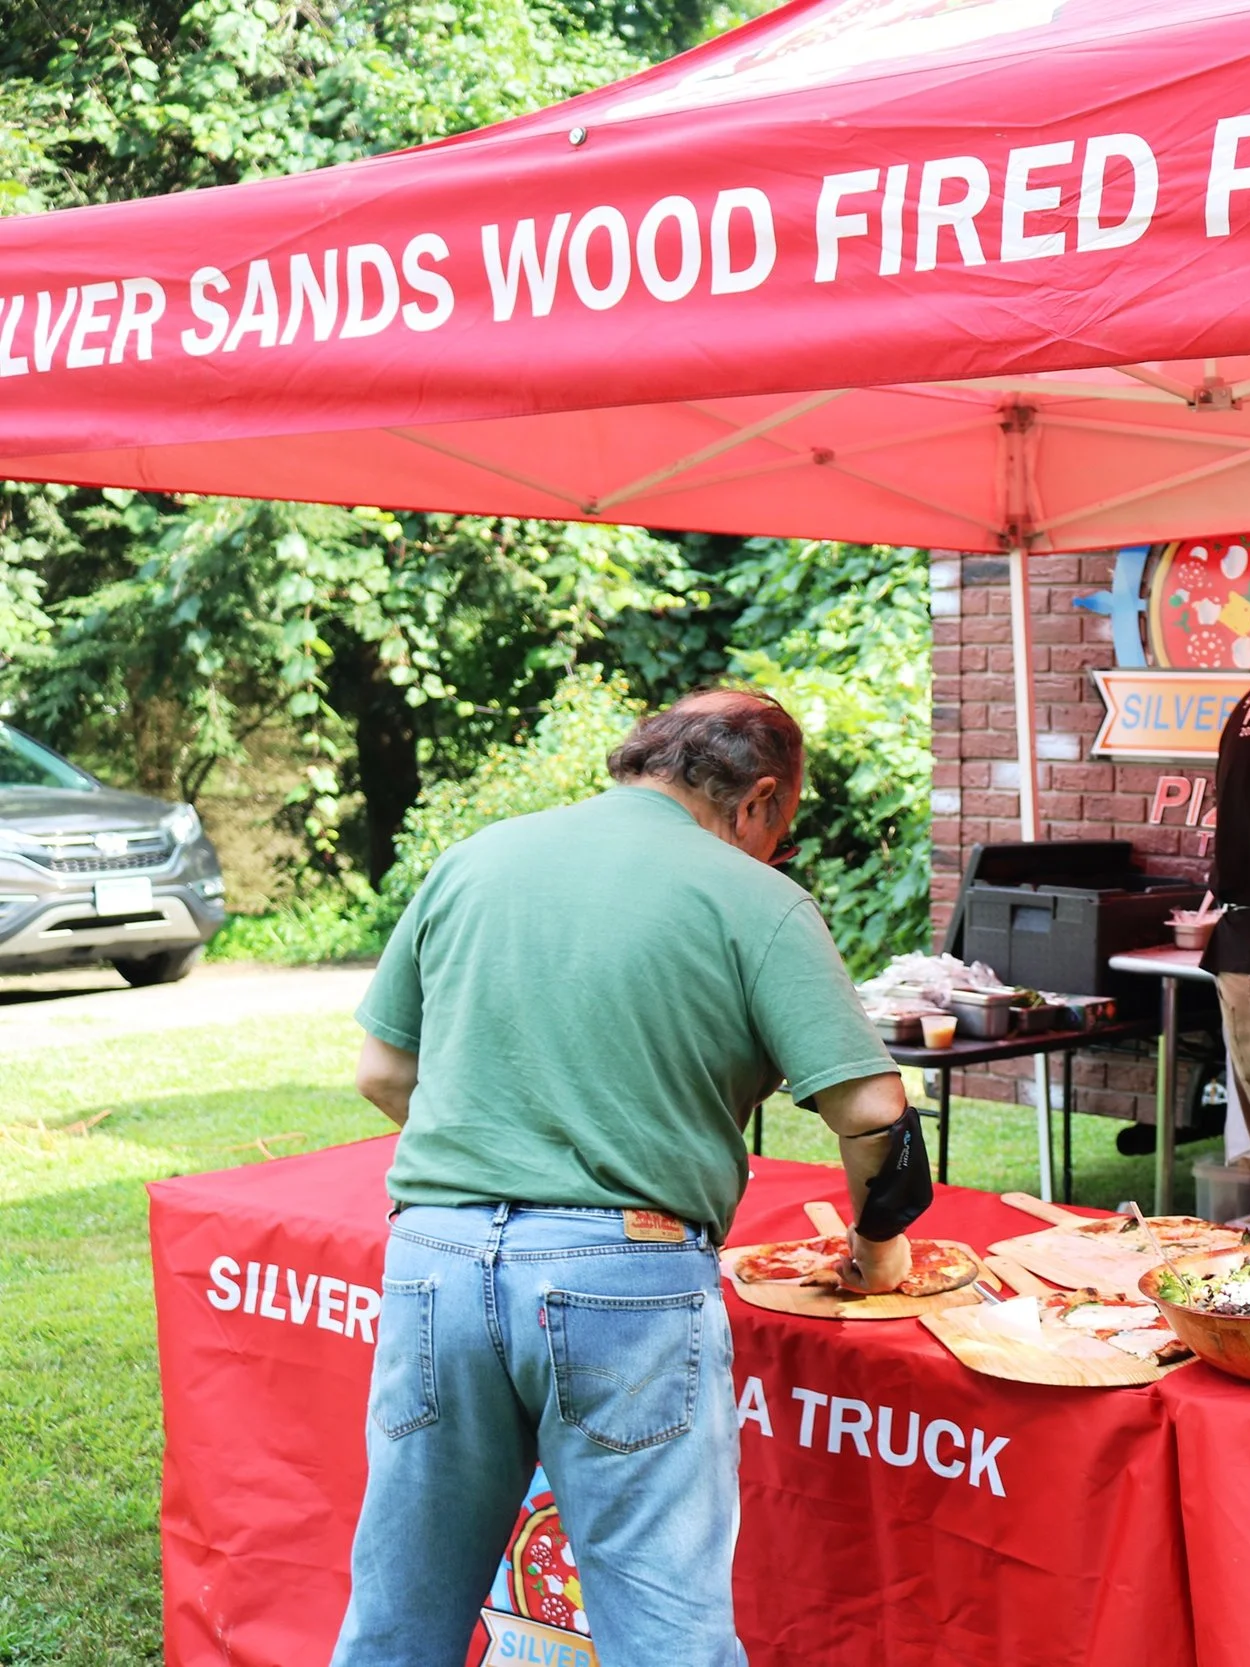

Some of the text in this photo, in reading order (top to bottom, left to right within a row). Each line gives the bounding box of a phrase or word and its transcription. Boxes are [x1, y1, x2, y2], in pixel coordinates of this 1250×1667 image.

[0, 277, 166, 377] LVER
[181, 232, 454, 357] SANDS
[482, 187, 777, 323] WOOD
[813, 133, 1159, 284] FIRED
[206, 1255, 382, 1344] SILVER
[791, 1387, 1011, 1498] TRUCK
